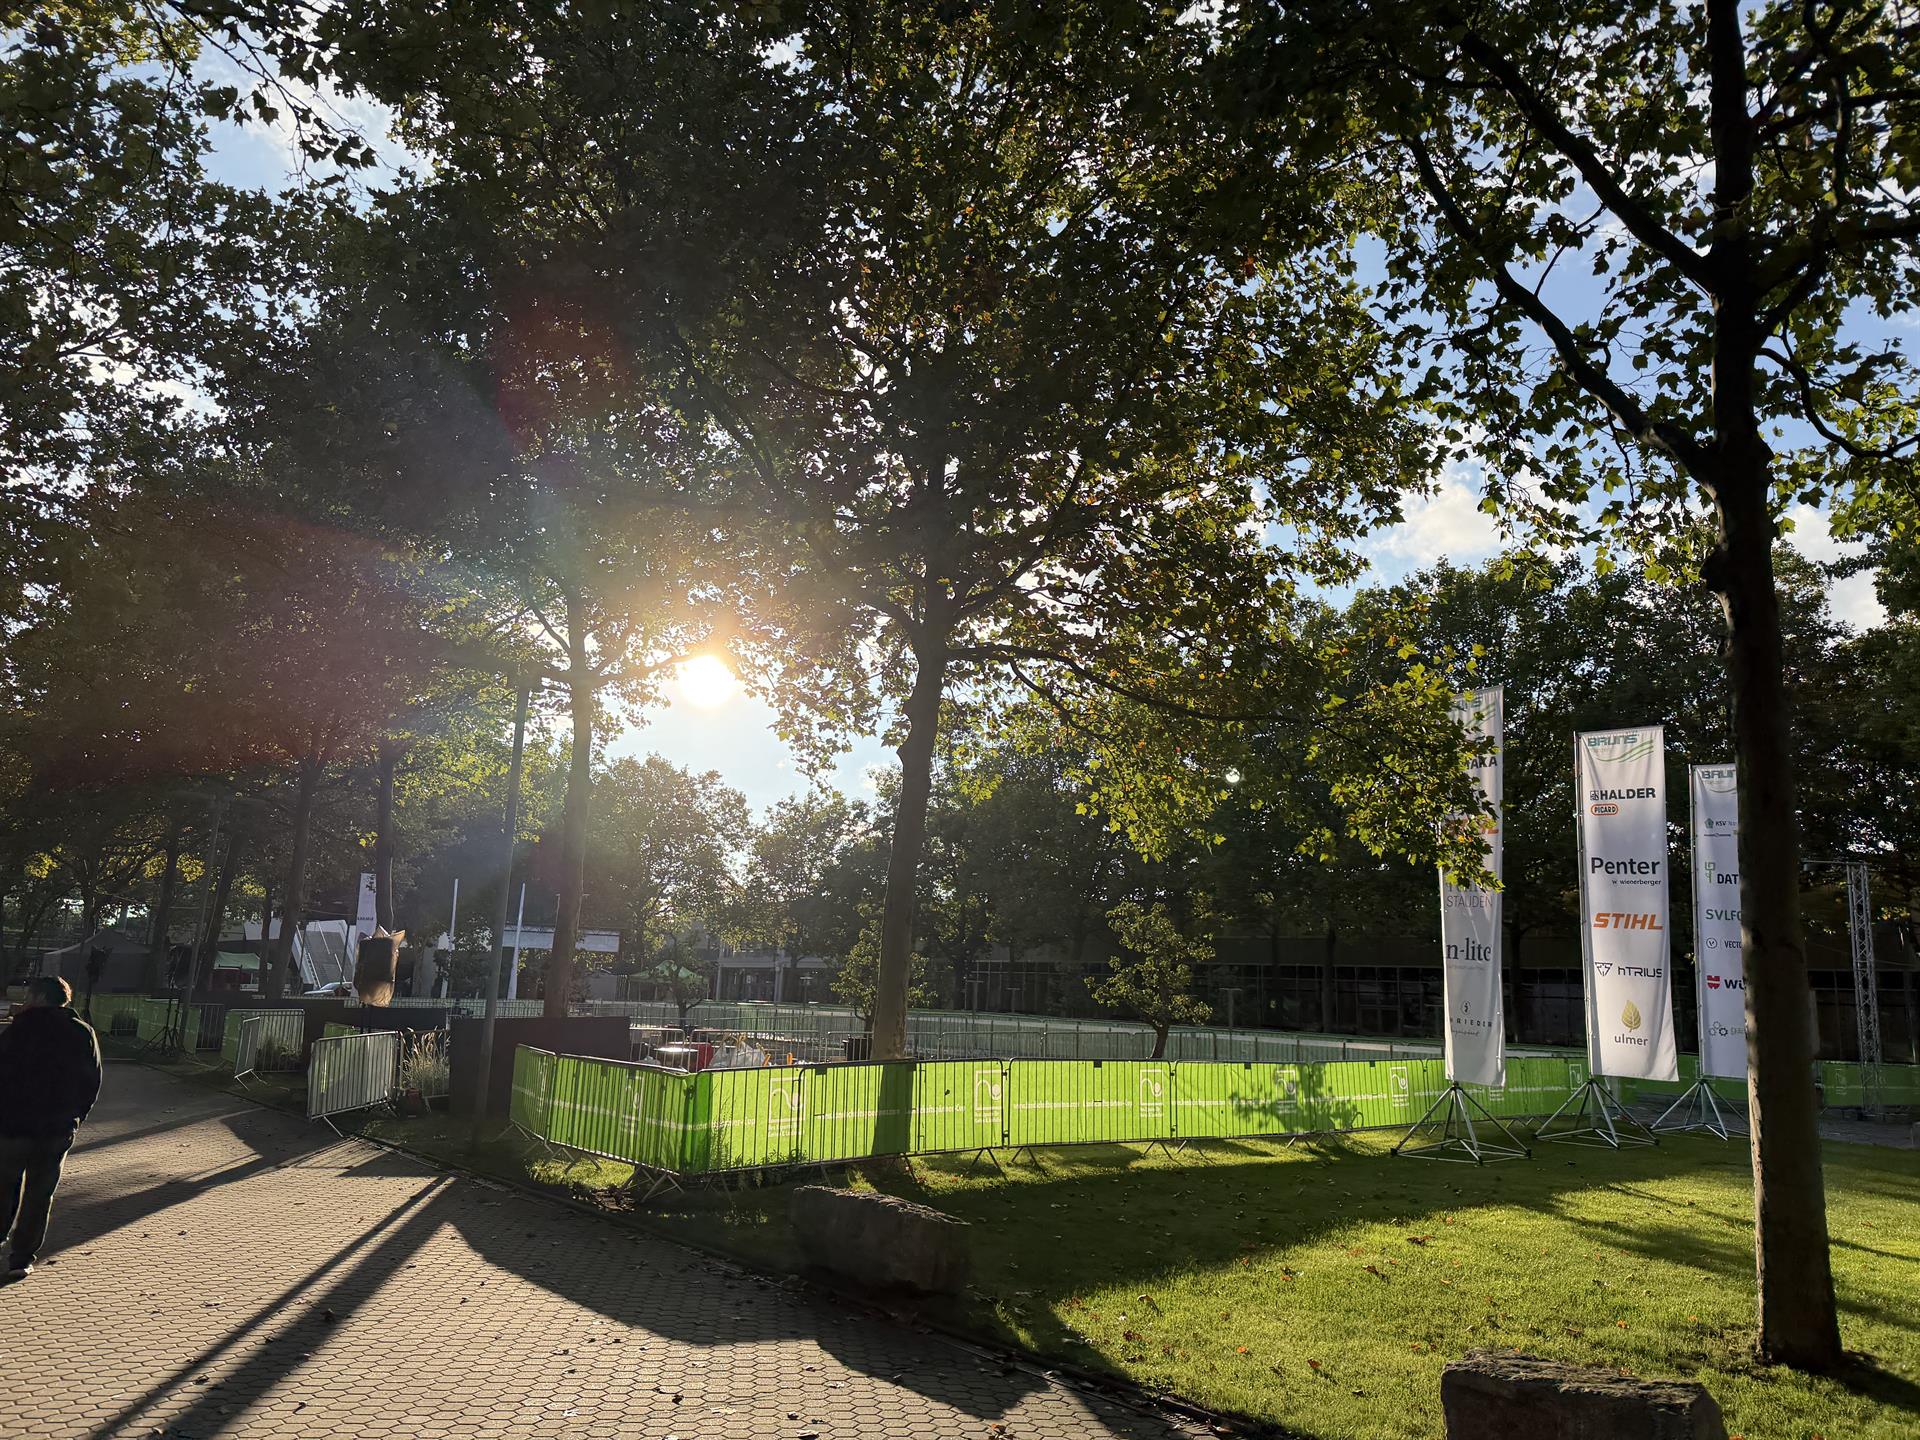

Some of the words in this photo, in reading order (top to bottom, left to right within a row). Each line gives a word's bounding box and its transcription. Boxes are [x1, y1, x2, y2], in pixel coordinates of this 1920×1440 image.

[1600, 788, 1656, 800] HALDER
[1591, 857, 1660, 875] Penter
[1446, 896, 1493, 908] STAUDEN
[1593, 912, 1664, 930] STIHL
[1614, 1033, 1648, 1046] ulmer
